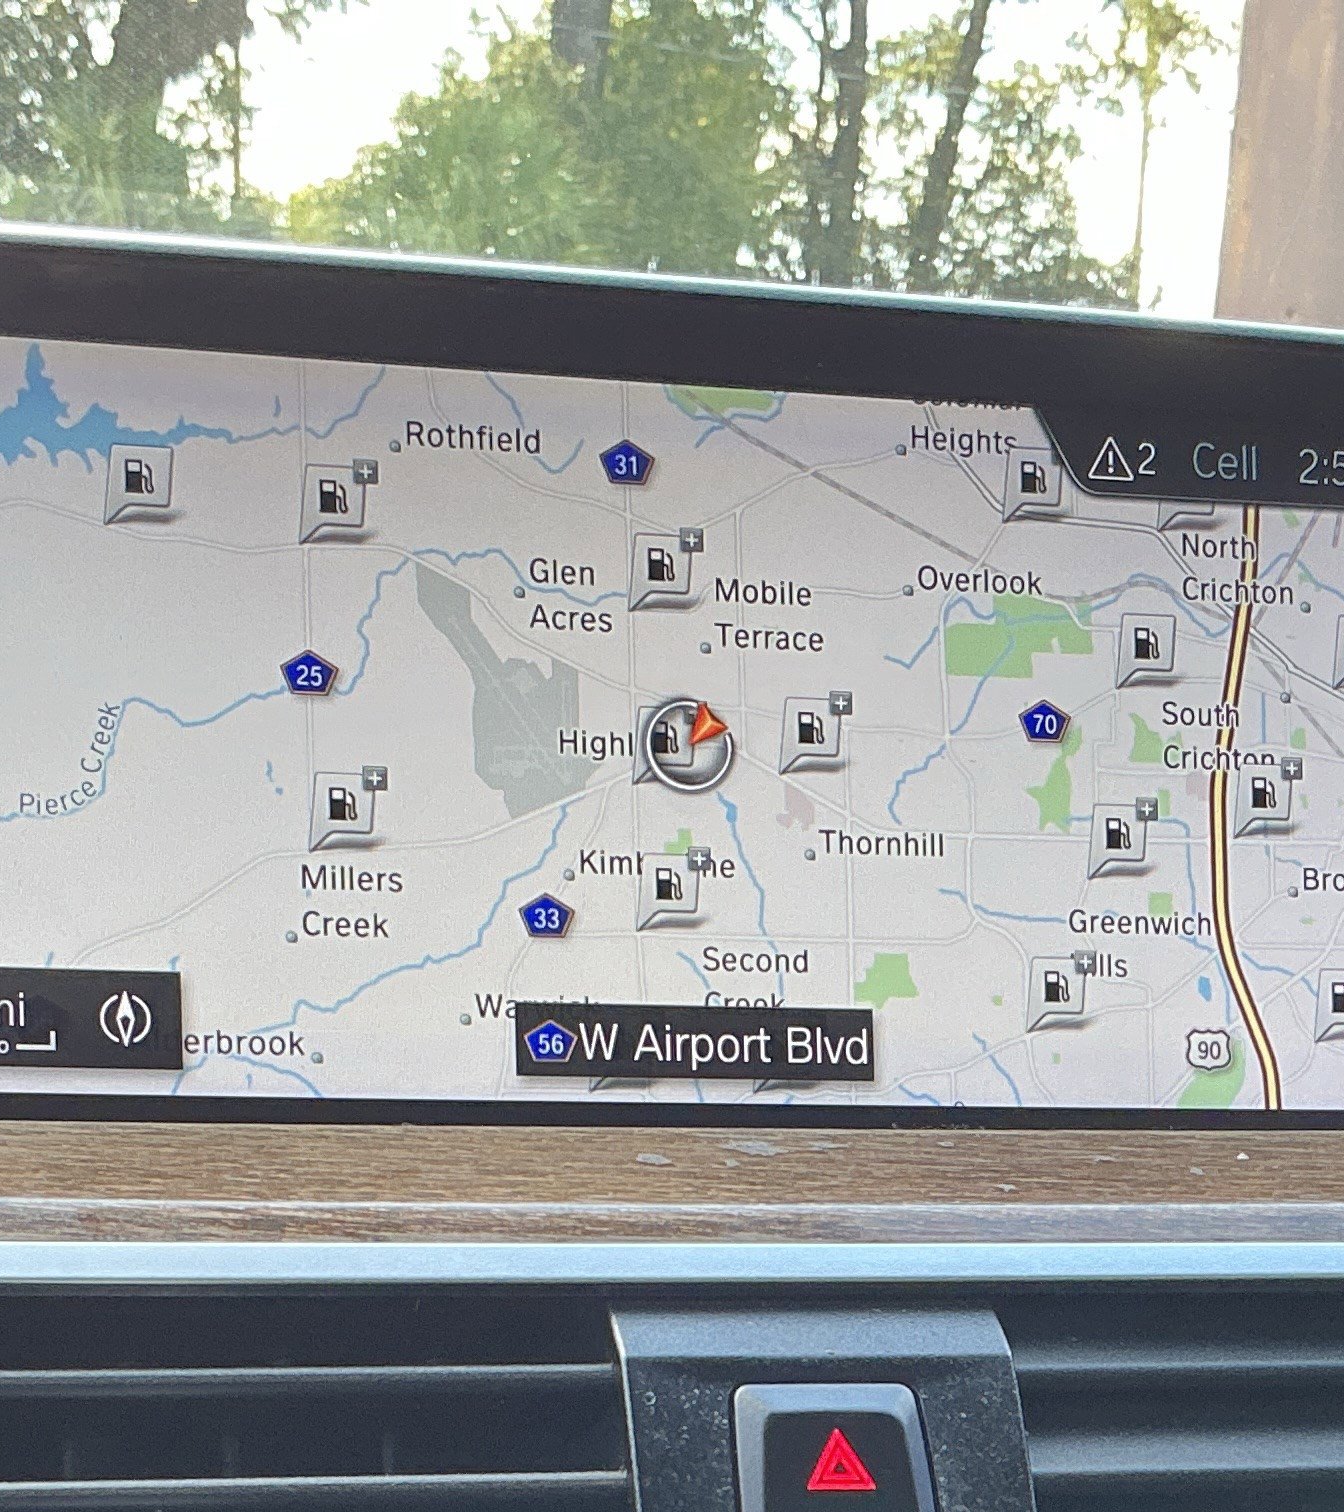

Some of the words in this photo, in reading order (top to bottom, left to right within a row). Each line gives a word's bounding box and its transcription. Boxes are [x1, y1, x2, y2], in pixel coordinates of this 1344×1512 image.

[406, 421, 541, 454] Rothfield
[911, 425, 1017, 458] Heights
[615, 455, 638, 476] 31
[1137, 443, 1156, 476] 2
[1192, 443, 1258, 481] Cell
[1181, 535, 1257, 560] North
[529, 558, 596, 586] Glen
[918, 566, 1043, 596] Overlook
[714, 578, 812, 606] Mobile
[1182, 577, 1294, 605] Crichton
[529, 604, 614, 633] Acres
[714, 623, 824, 652] Terrace
[296, 664, 323, 687] 25
[1034, 714, 1057, 734] 70
[1162, 701, 1239, 727] South
[20, 781, 97, 815] Pierce
[80, 702, 120, 772] Creek
[559, 729, 633, 761] Highl
[819, 829, 944, 858] Thornhill
[301, 866, 403, 893] Millers
[302, 912, 389, 938] Creek
[534, 908, 560, 929] 33
[1069, 909, 1212, 936] Greenwich
[702, 947, 809, 974] Second
[183, 1030, 304, 1058] erbrook
[538, 1033, 564, 1055] 56
[579, 1023, 618, 1061] W
[634, 1024, 772, 1070] Airport
[787, 1027, 868, 1065] Blvd
[1198, 1041, 1221, 1060] 90
